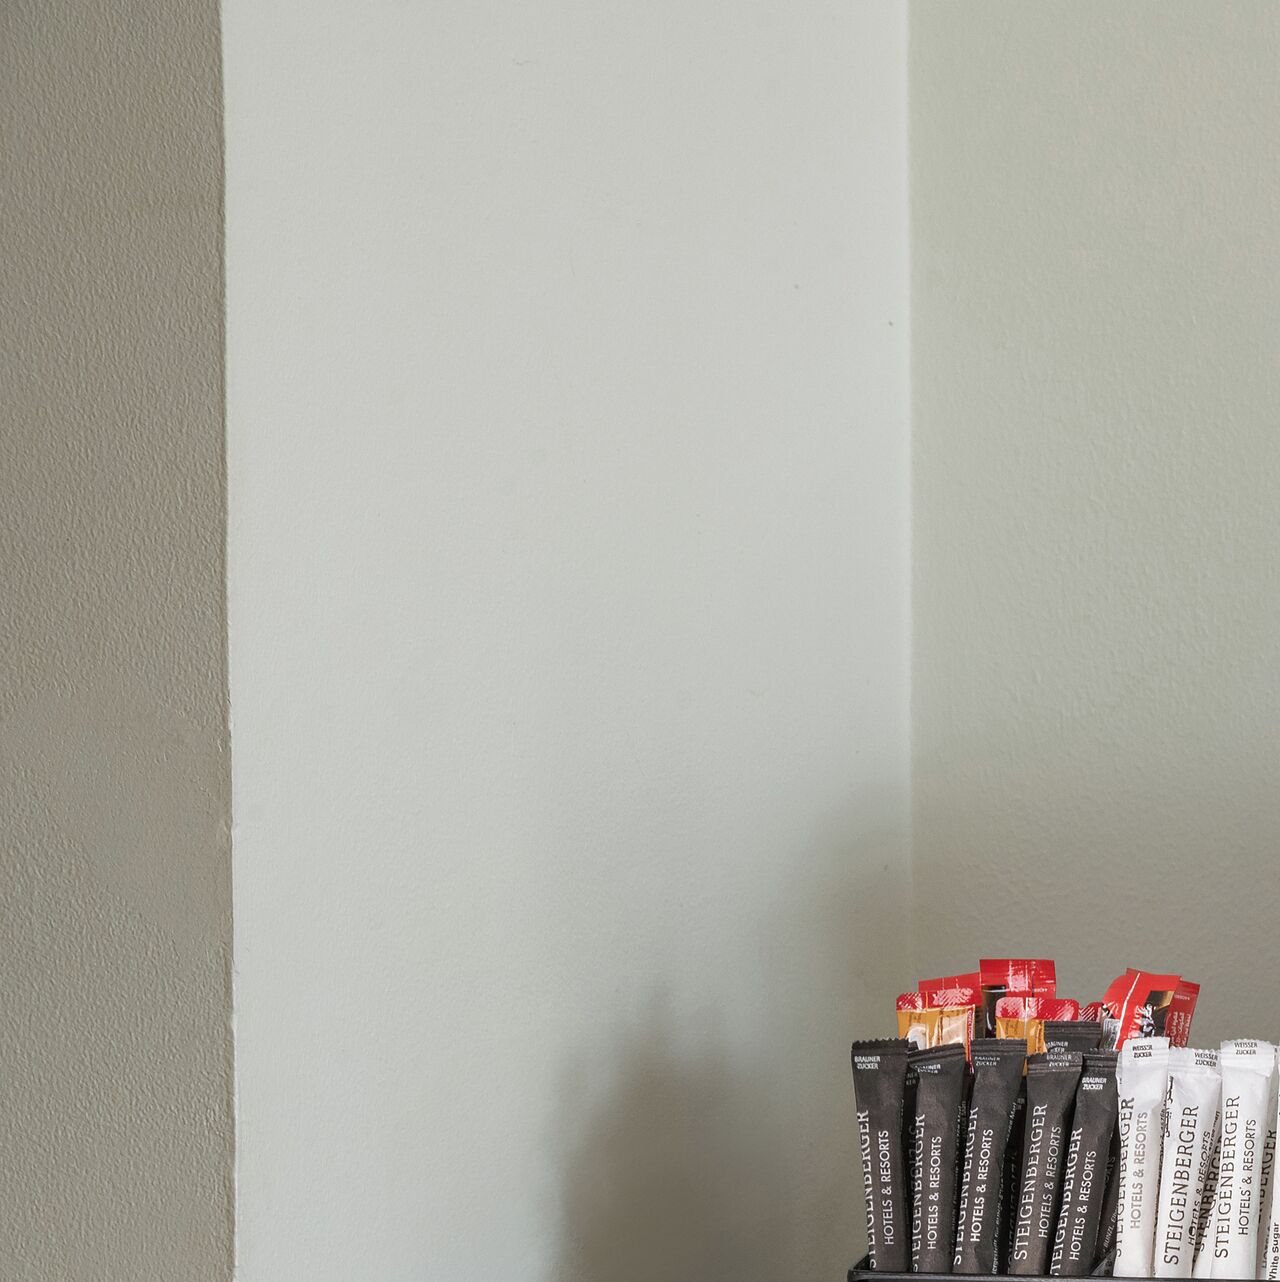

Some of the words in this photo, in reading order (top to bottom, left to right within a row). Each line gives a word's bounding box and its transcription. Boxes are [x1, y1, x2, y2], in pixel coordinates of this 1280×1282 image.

[857, 1062, 878, 1070] ZUCKER
[1194, 1052, 1218, 1061] WEISSER
[1195, 1059, 1217, 1067] ZUCKER
[878, 1130, 891, 1182] RESORTS
[977, 1129, 994, 1180] RESORTS
[1046, 1126, 1061, 1178] RESORTS
[1135, 1111, 1148, 1164] RESORTS
[1198, 1131, 1210, 1183] RESORTS
[1243, 1119, 1257, 1171] RESORTS
[929, 1136, 942, 1188] RESORTS
[1013, 1103, 1048, 1260] STEIGENBERGER
[1079, 1150, 1097, 1202] RESORTS
[1132, 1166, 1144, 1178] &
[1215, 1095, 1240, 1259] STEIGENBERGER
[1242, 1175, 1253, 1186] &
[882, 1185, 892, 1195] &
[929, 1192, 939, 1201] &
[976, 1183, 987, 1193] &
[1044, 1181, 1054, 1190] &
[1050, 1127, 1083, 1276] TEIGENBERGER
[1130, 1182, 1143, 1229] HOTELS
[1163, 1105, 1199, 1265] STEIGENBERGER
[882, 1199, 894, 1245] HOTELS
[927, 1205, 939, 1249] HOTELS
[970, 1197, 985, 1242] HOTELS
[1038, 1194, 1053, 1239] HOTELS
[1077, 1205, 1088, 1214] &
[1238, 1189, 1252, 1236] HOTELS
[1069, 1216, 1086, 1260] HOTELS
[1272, 1222, 1280, 1253] Sugar
